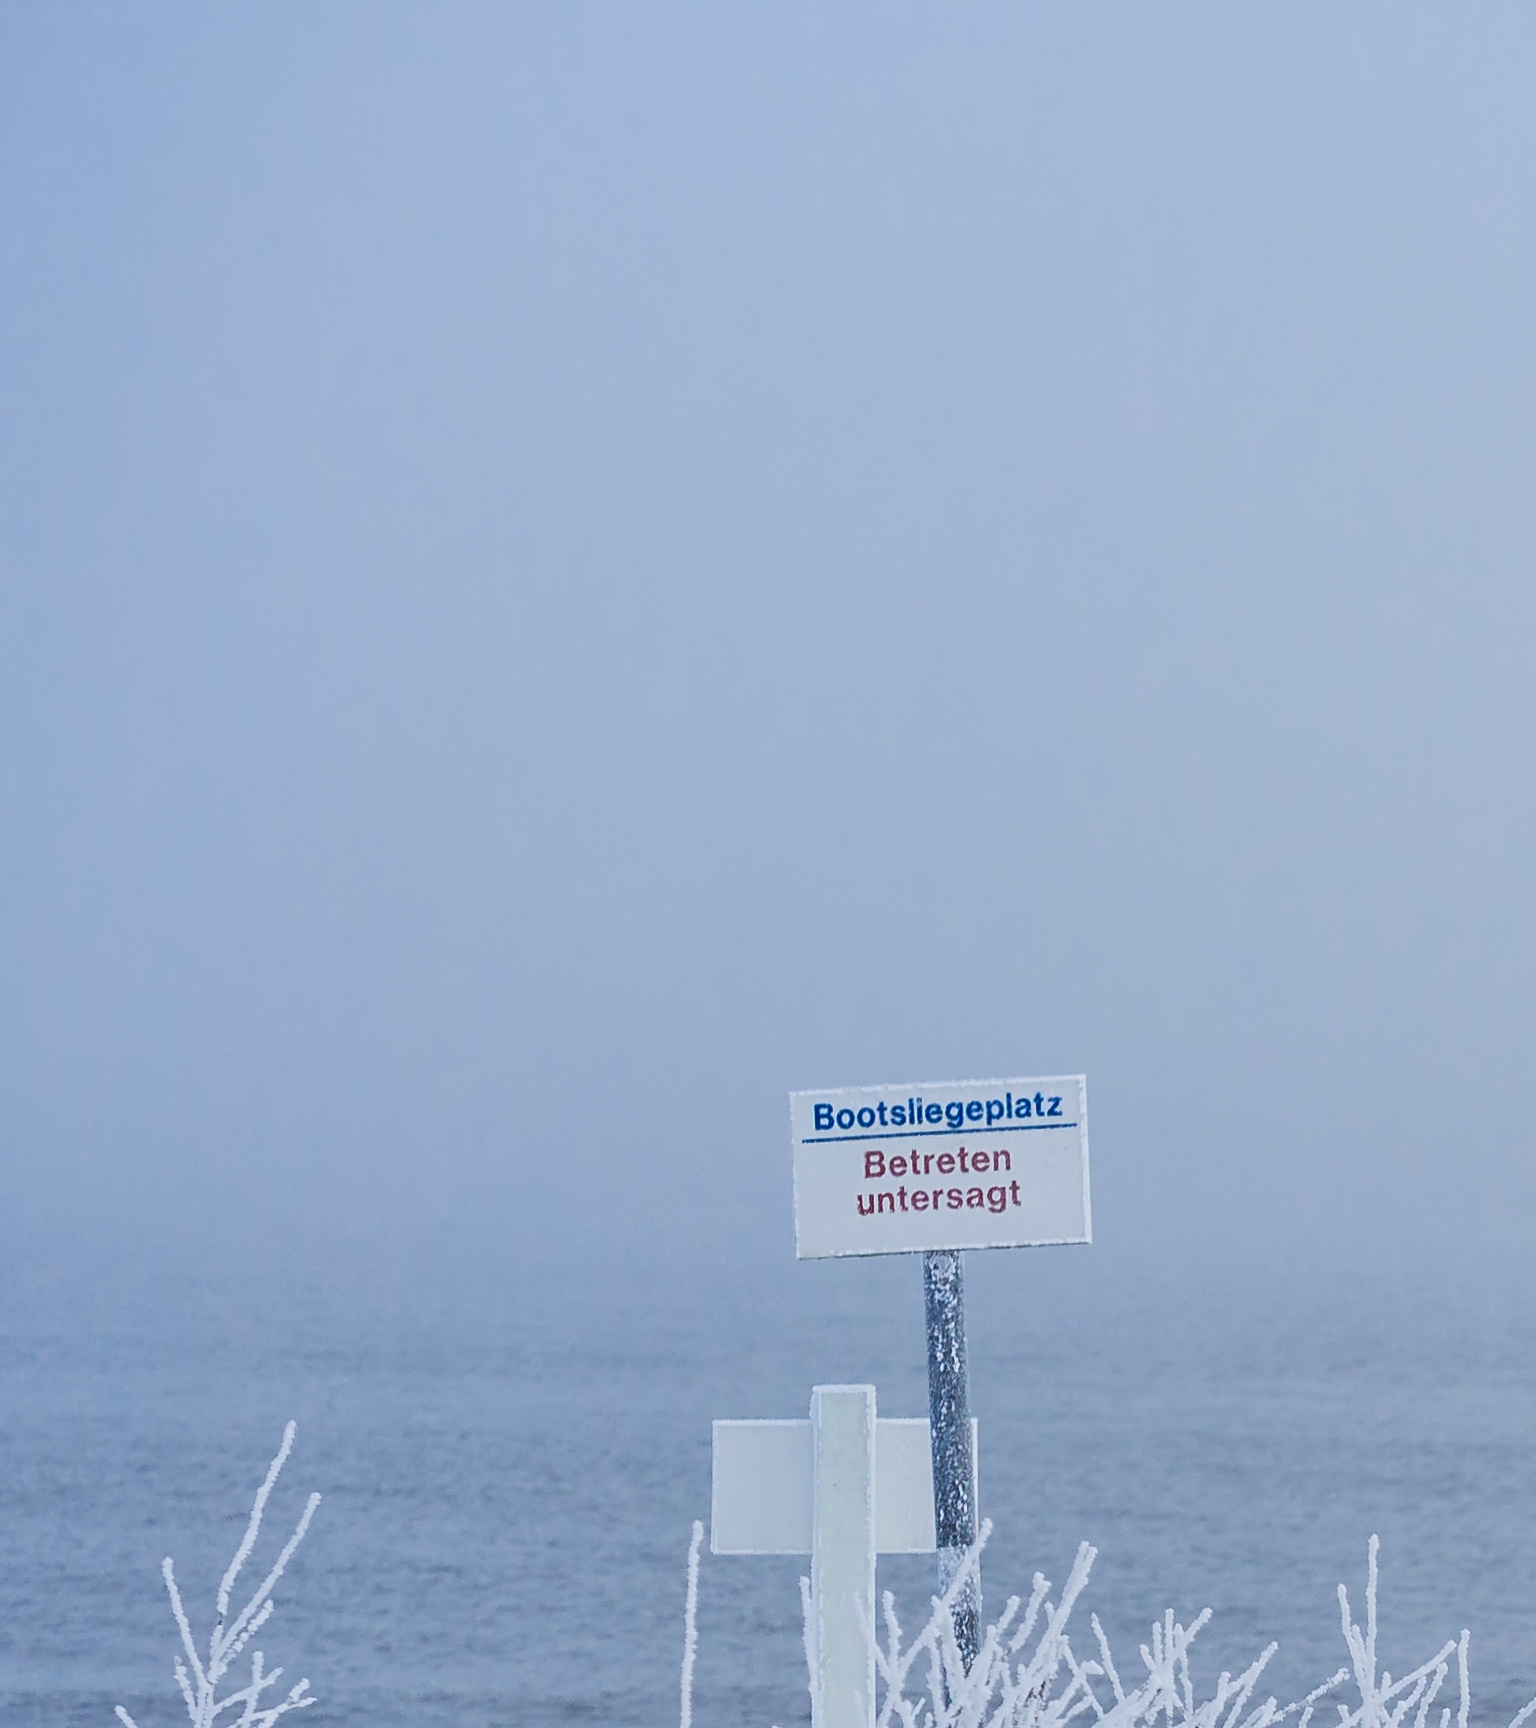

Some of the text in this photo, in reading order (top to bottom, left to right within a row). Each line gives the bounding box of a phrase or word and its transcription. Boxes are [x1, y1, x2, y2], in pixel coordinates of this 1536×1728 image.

[813, 1092, 1064, 1131] Bootsliegeplatz
[864, 1147, 1011, 1179] Betreten
[857, 1180, 1022, 1216] untersagt
